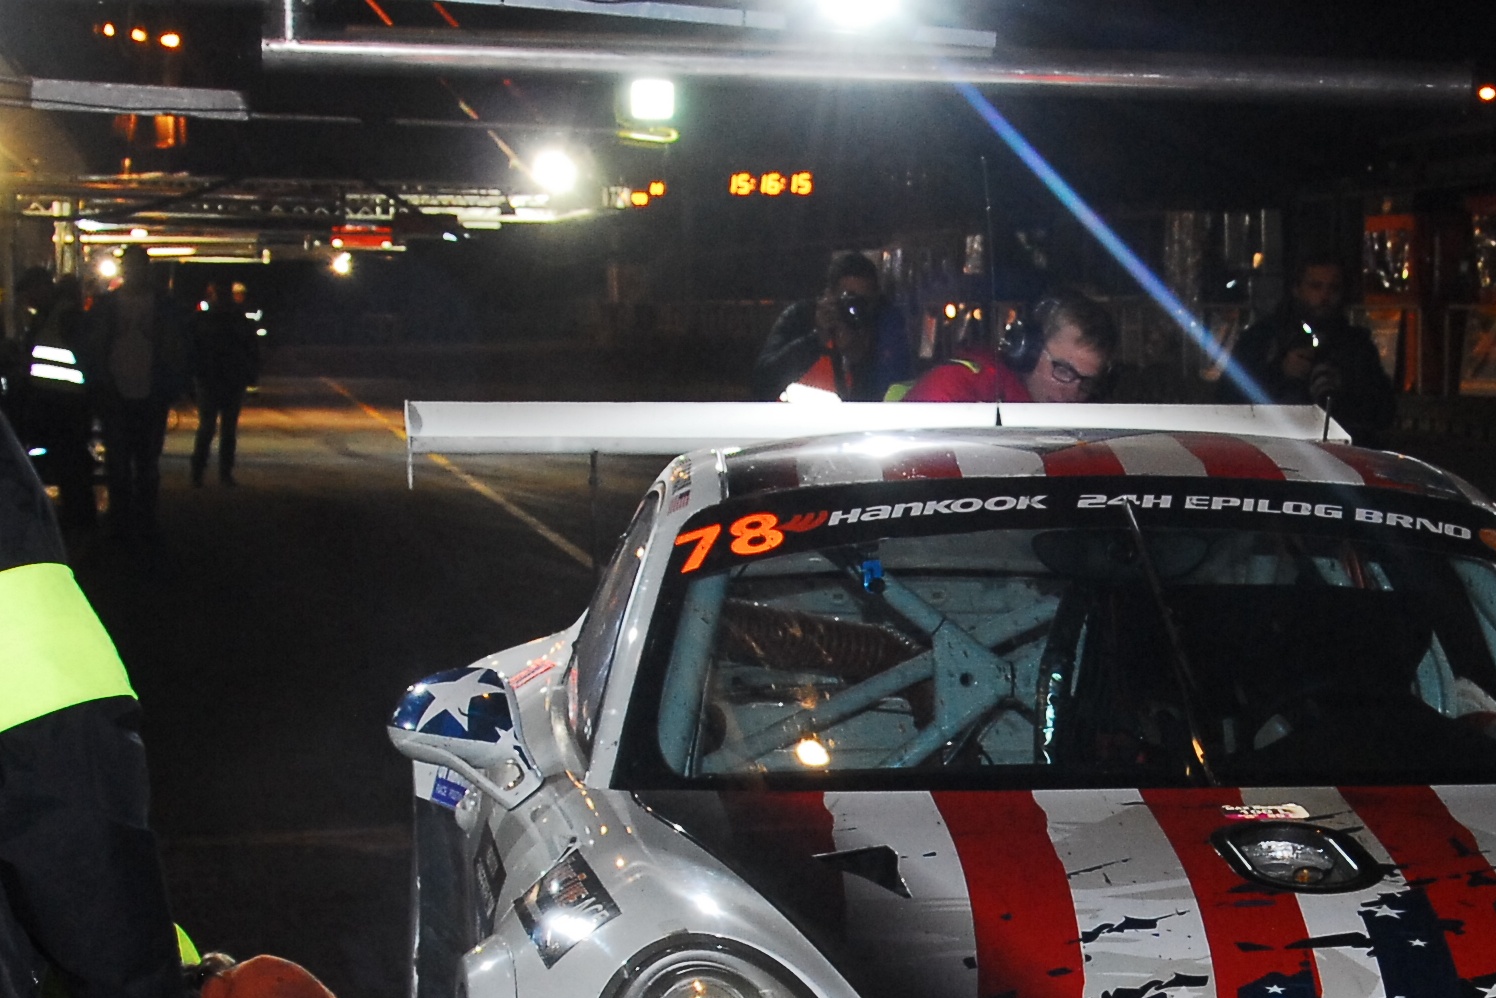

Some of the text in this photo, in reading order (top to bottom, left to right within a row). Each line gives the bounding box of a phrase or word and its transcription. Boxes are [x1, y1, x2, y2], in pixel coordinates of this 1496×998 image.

[729, 171, 813, 196] 15:16:15
[1076, 493, 1472, 540] 24H EPILOG BRNO
[674, 511, 786, 574] 78
